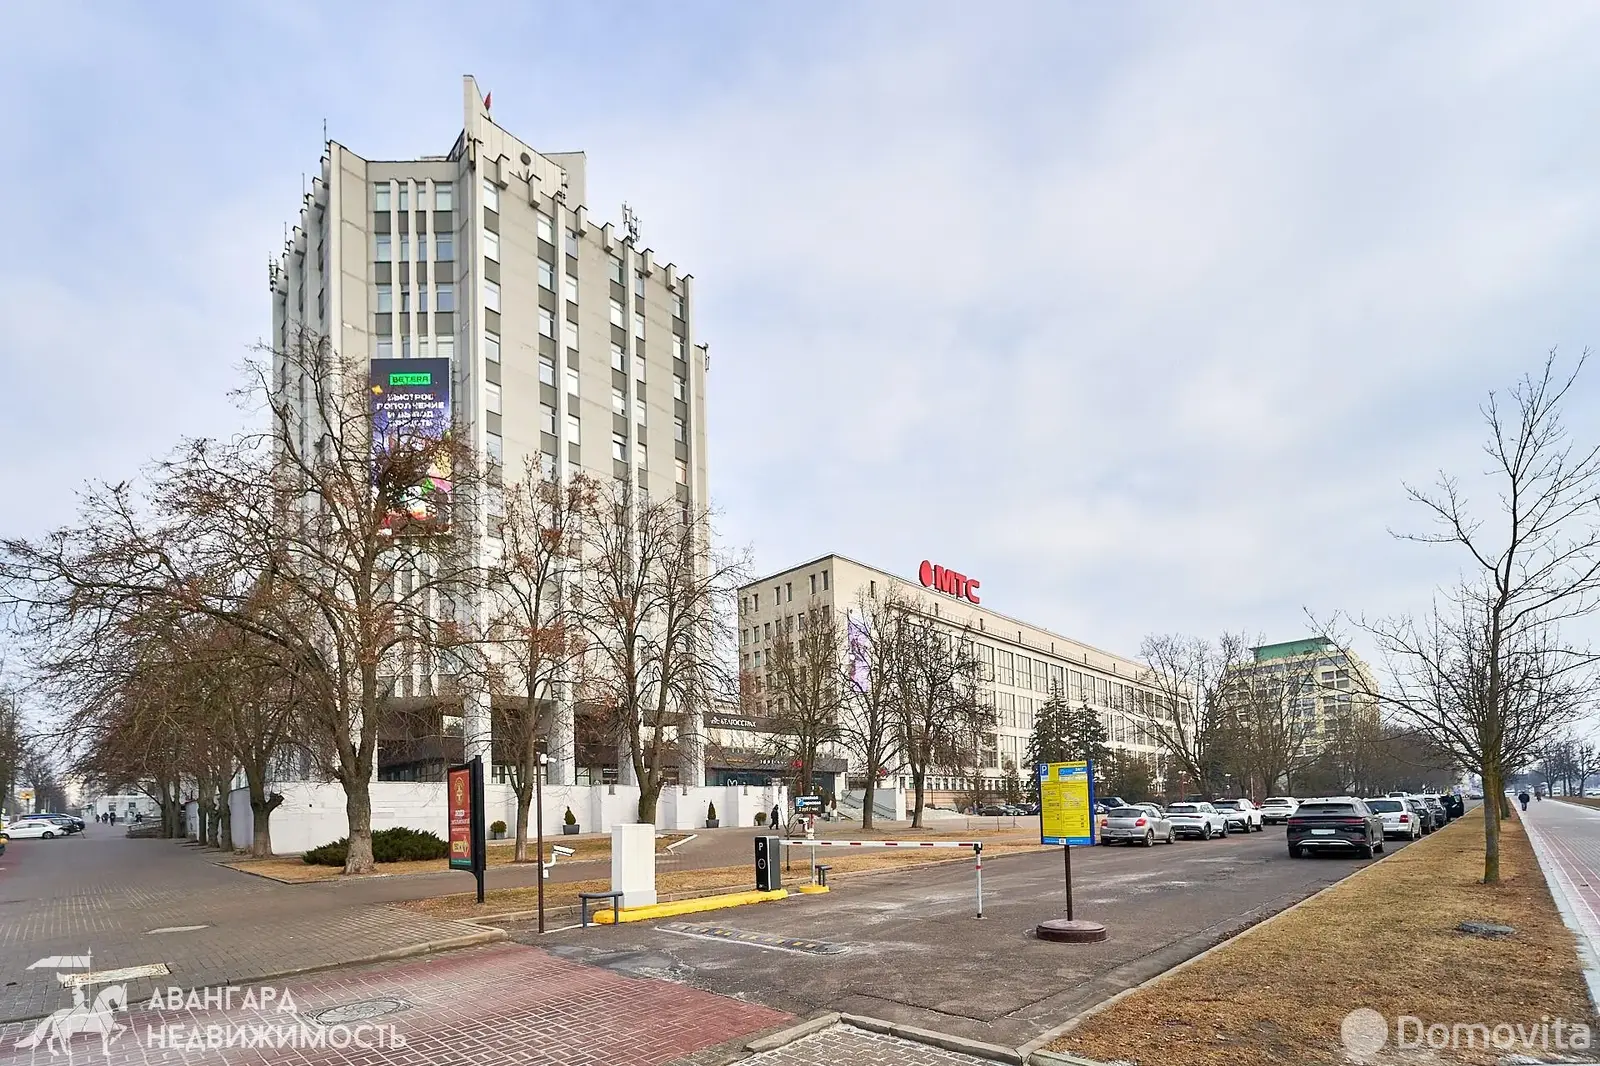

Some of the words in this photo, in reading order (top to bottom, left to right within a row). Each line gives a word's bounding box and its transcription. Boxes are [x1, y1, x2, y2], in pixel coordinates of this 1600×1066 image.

[392, 375, 429, 383] BETERA
[934, 565, 980, 604] МТС
[1042, 765, 1048, 774] P
[758, 842, 764, 851] P
